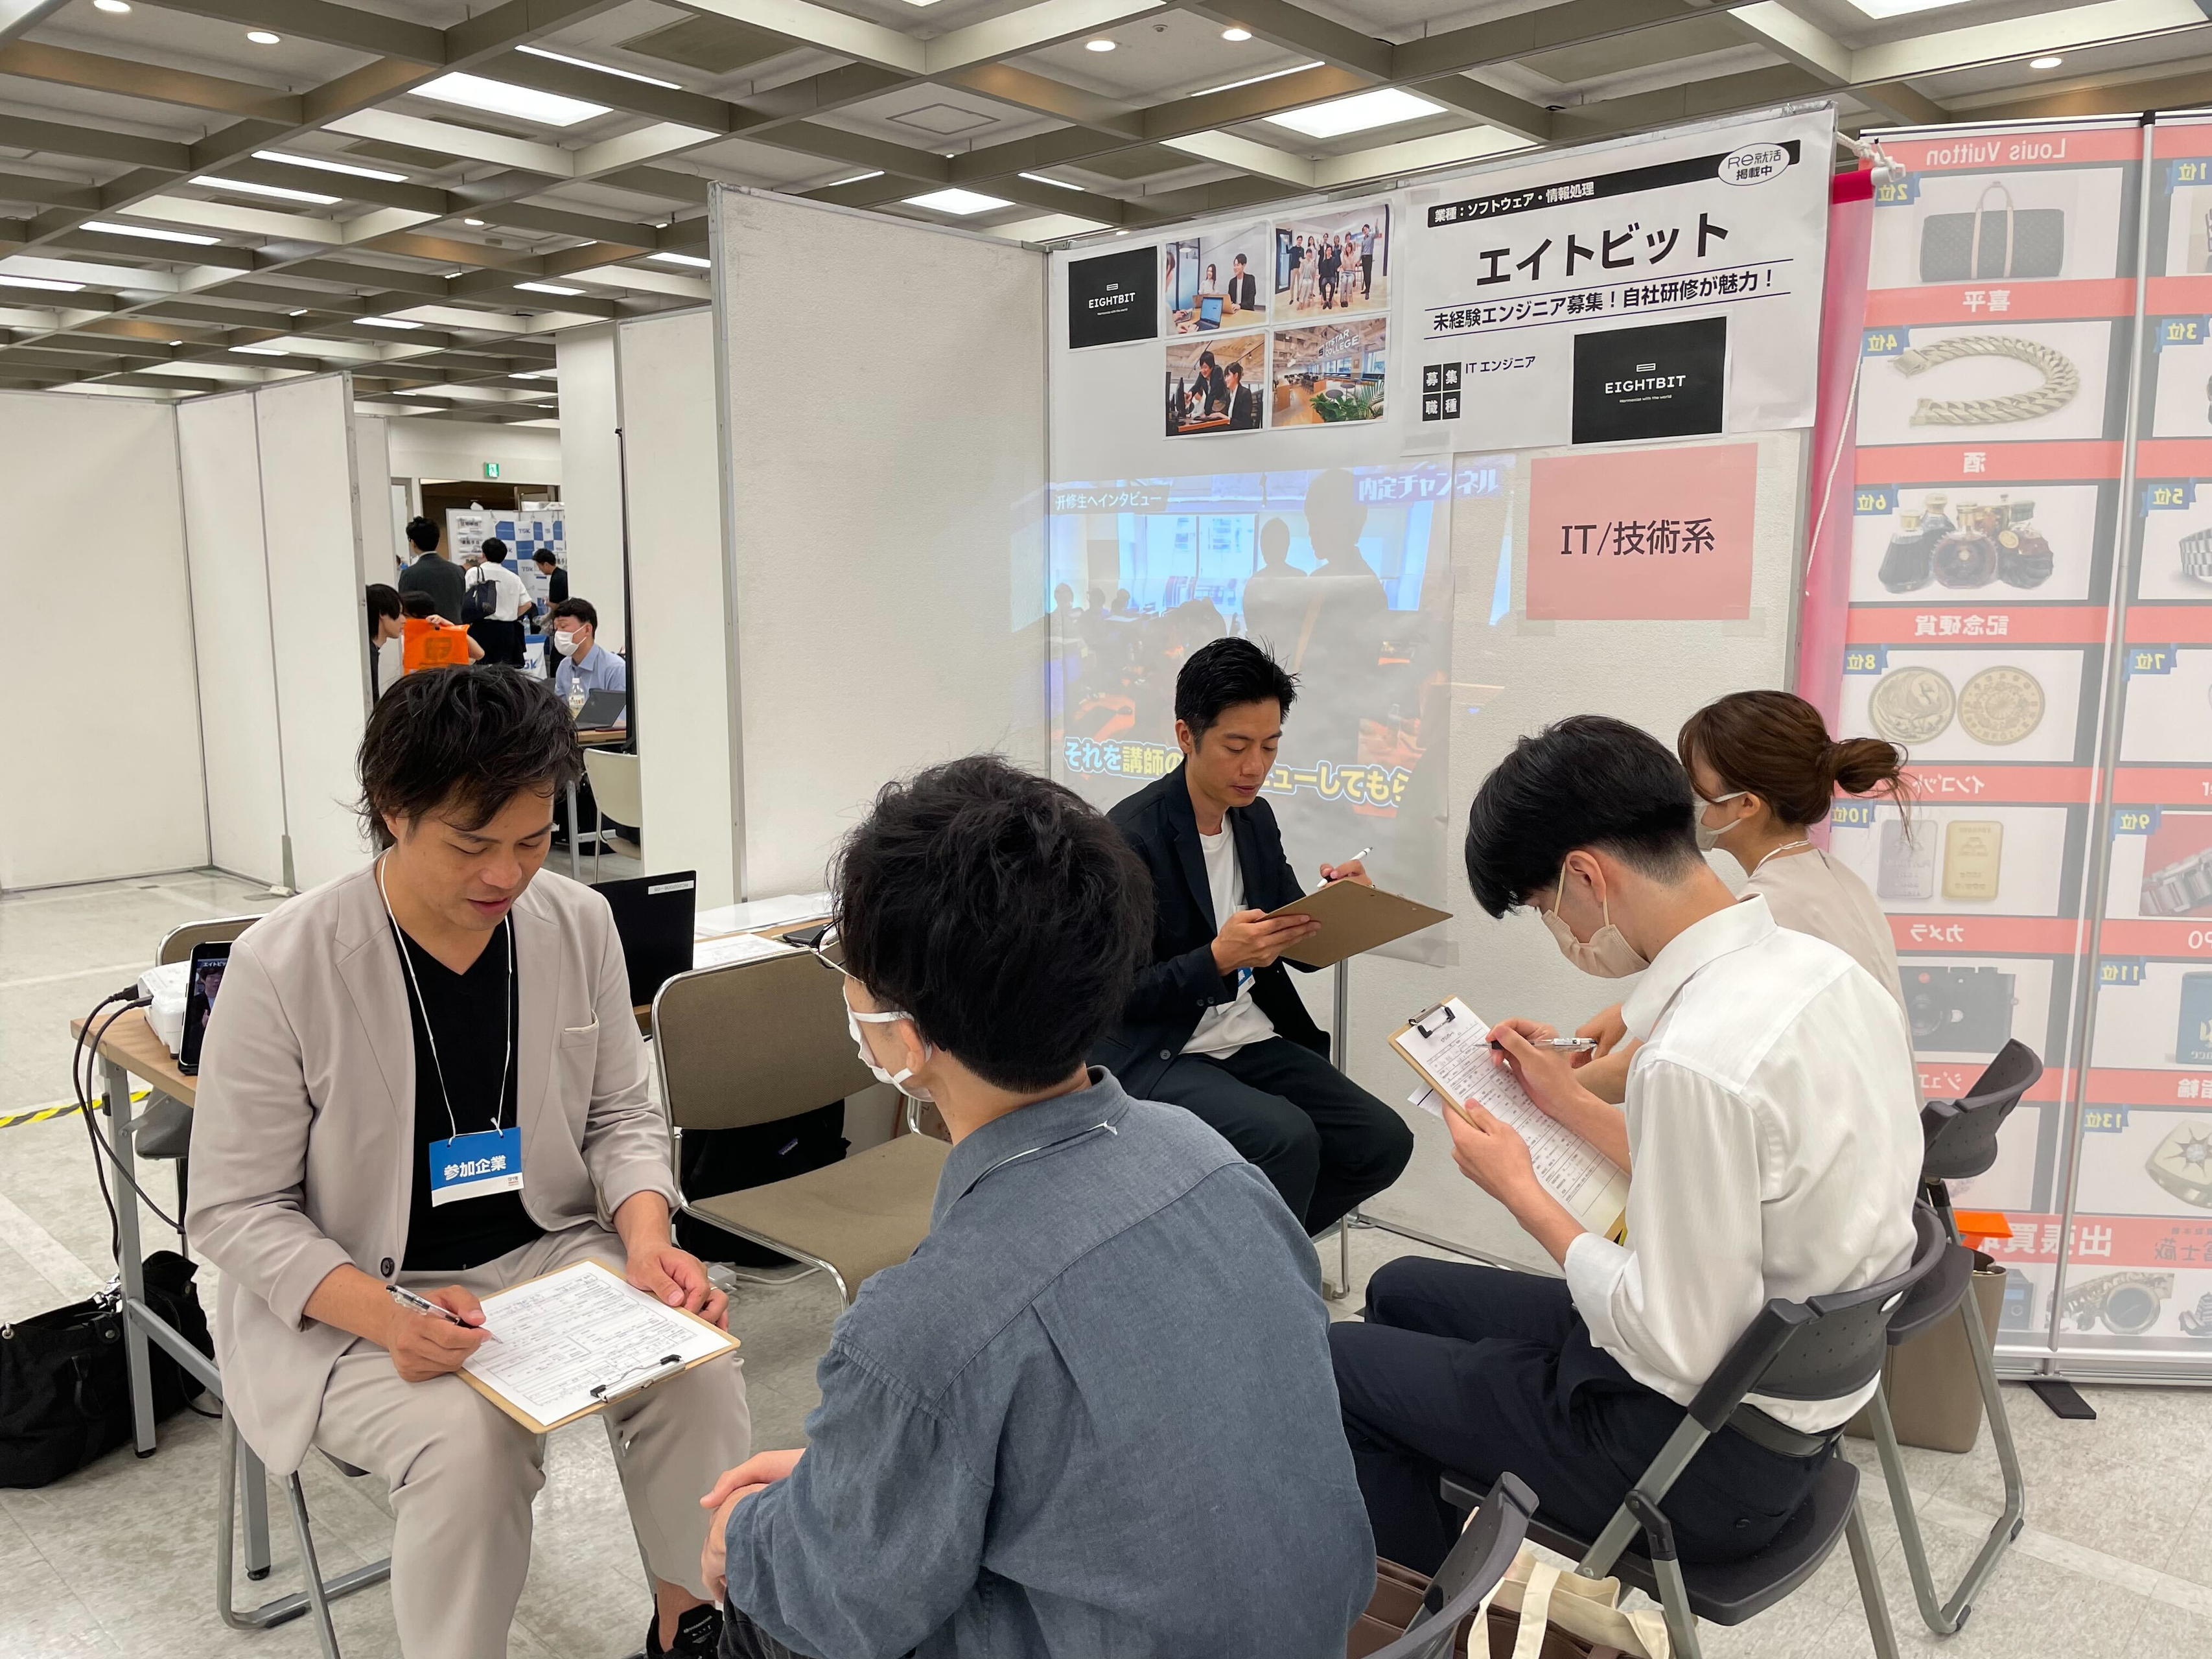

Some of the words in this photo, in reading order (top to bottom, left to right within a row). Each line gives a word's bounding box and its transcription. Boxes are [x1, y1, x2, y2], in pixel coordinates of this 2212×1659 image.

[1728, 149, 1781, 169] Re就活
[1736, 165, 1773, 180] 掲載中
[1476, 212, 1729, 286] エイトビット
[1088, 292, 1135, 308] EIGHTBIT
[1325, 334, 1359, 356] COLLEGE
[1465, 362, 1477, 374] IT
[1480, 356, 1536, 372] エンジニア
[1605, 375, 1686, 394] EIGHTBIT
[1358, 469, 1498, 501] 内定チャンネル
[1561, 517, 1716, 556] IT/技術系
[444, 1154, 507, 1181] 参加企業
